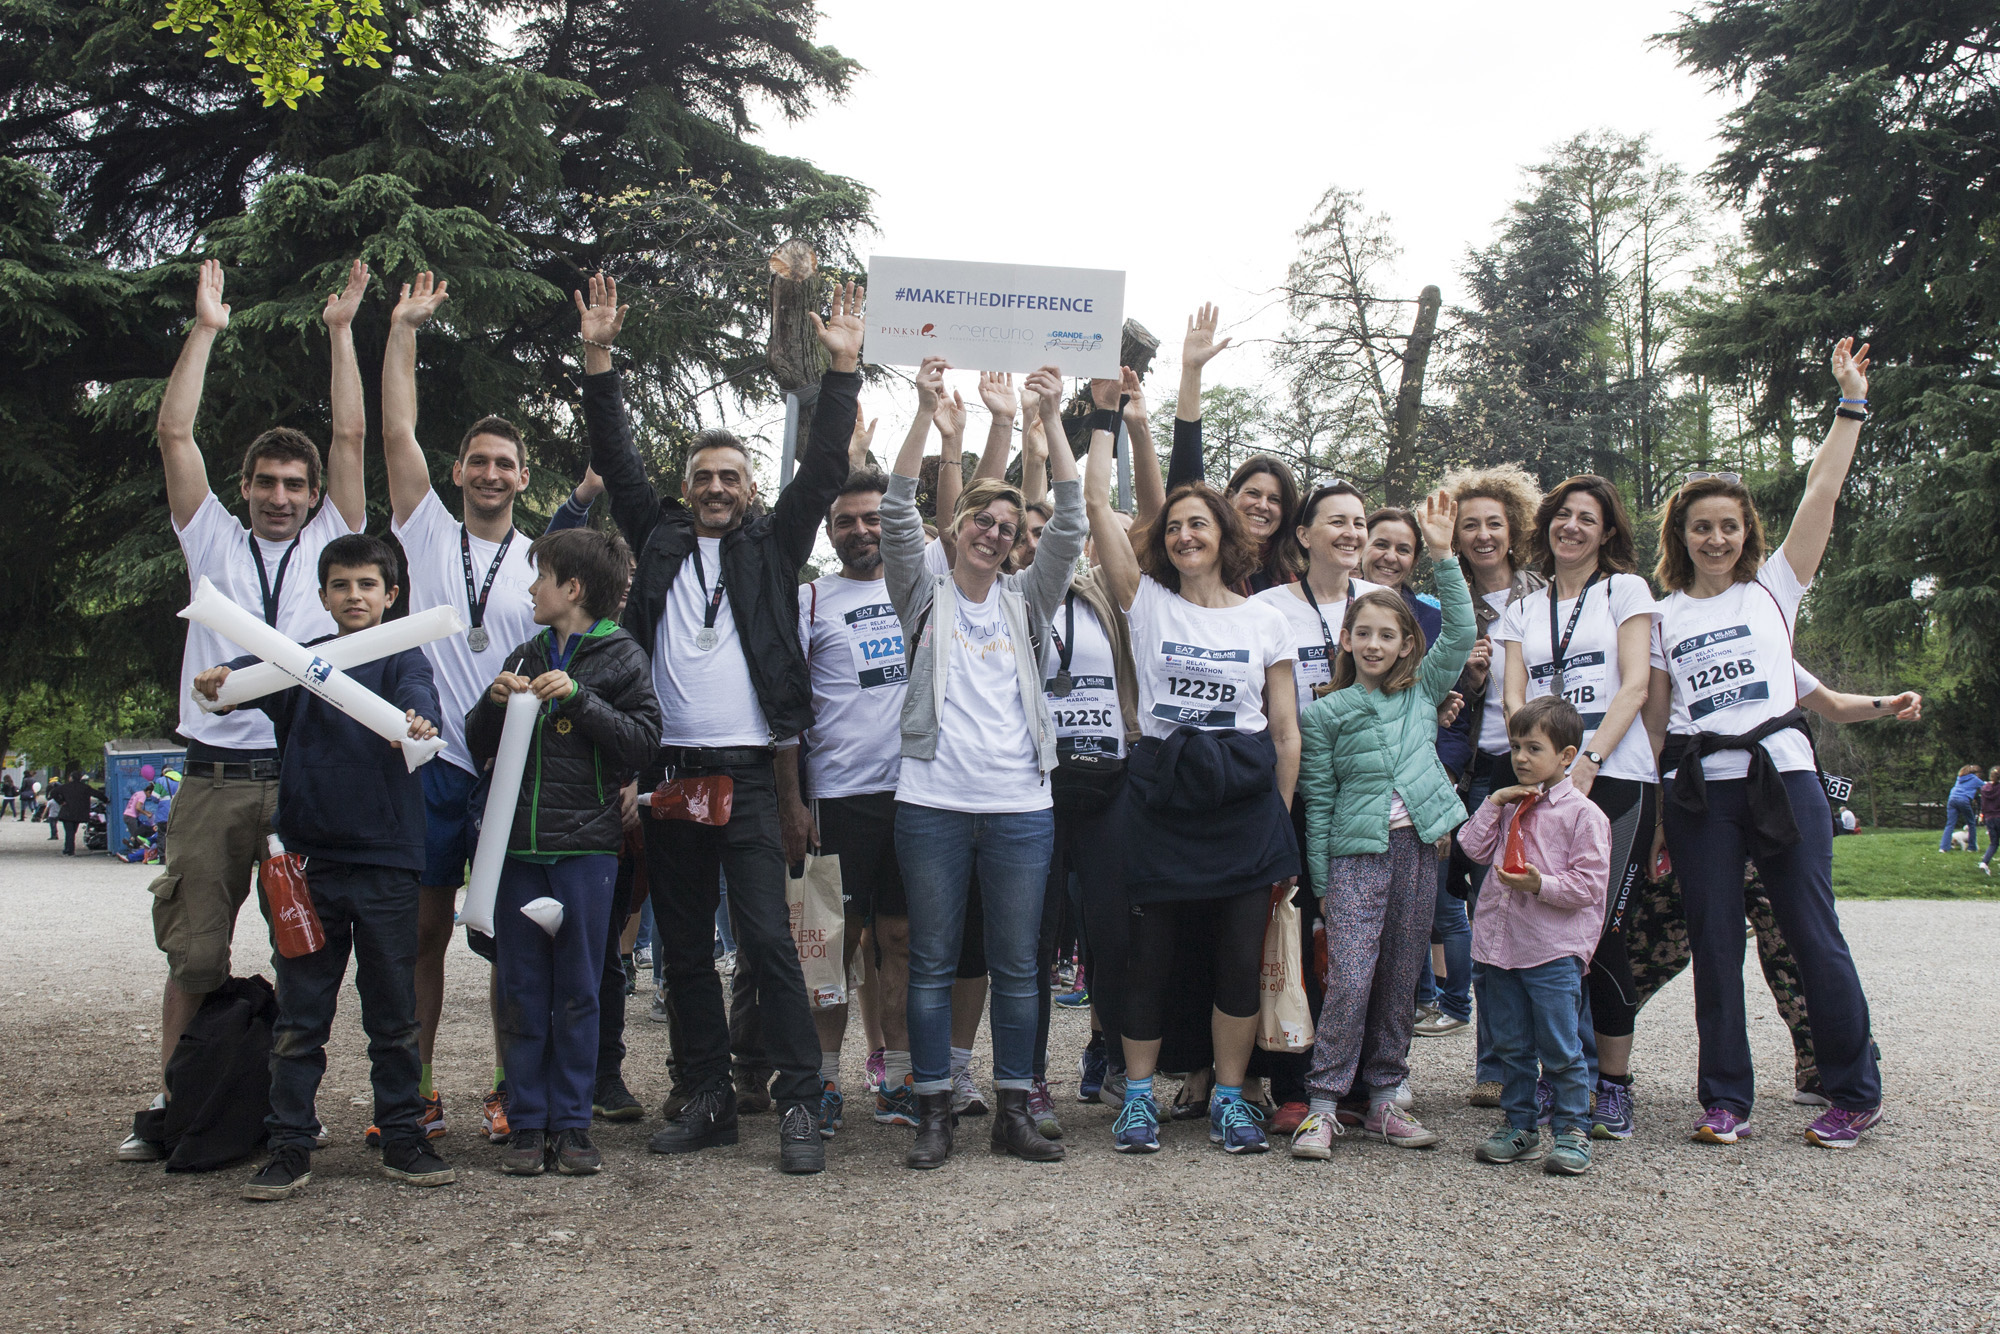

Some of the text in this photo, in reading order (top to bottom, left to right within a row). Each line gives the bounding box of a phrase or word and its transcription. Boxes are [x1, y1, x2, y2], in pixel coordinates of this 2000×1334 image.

[895, 288, 1093, 313] #MAKETHEDIFFERENCE
[950, 324, 1034, 341] mercurio
[871, 623, 900, 631] MARATHON
[1714, 629, 1736, 638] MILANO
[859, 636, 904, 660] 1223
[1175, 645, 1195, 654] EA7
[1308, 648, 1325, 657] EA7
[1680, 639, 1697, 652] EA7
[1695, 648, 1714, 657] RELAY
[1697, 649, 1732, 663] MARATHON
[1185, 666, 1223, 674] MARATHON
[1687, 658, 1755, 692] 1226B
[303, 673, 324, 687] AIRC
[1168, 677, 1236, 703] 1223B
[1712, 688, 1741, 706] EA7
[1054, 709, 1112, 727] 1223C
[1178, 707, 1210, 722] EA7
[1074, 736, 1102, 749] EA7
